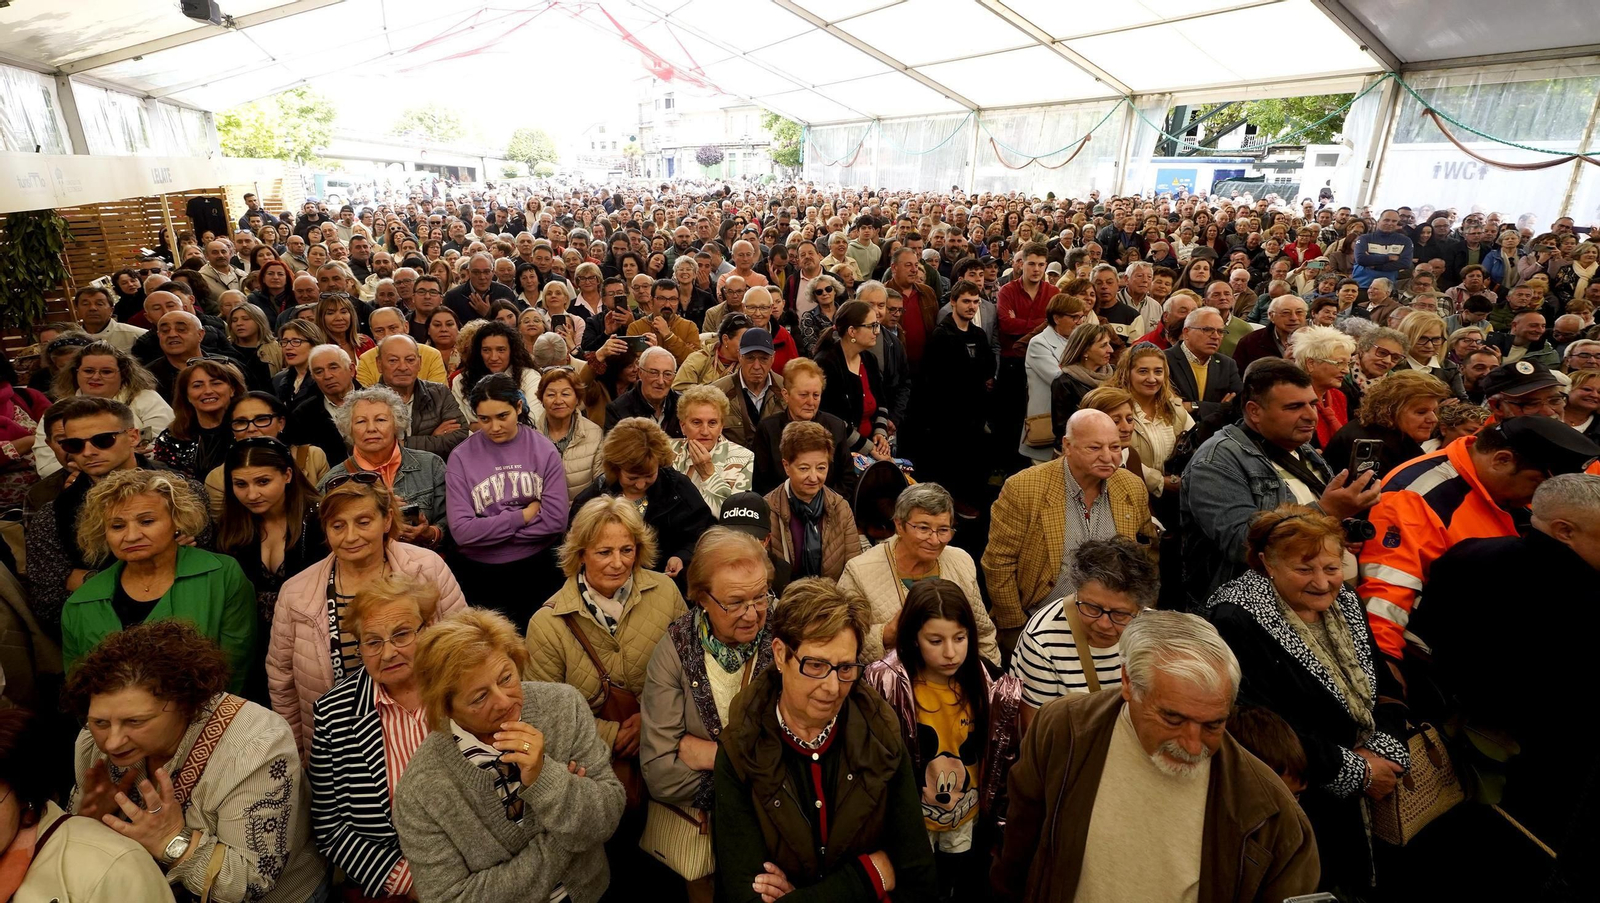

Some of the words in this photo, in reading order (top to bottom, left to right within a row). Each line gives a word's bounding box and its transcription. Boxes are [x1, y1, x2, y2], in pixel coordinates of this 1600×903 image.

[1444, 161, 1477, 180] WC
[471, 472, 505, 514] NEW
[723, 508, 760, 520] adidas
